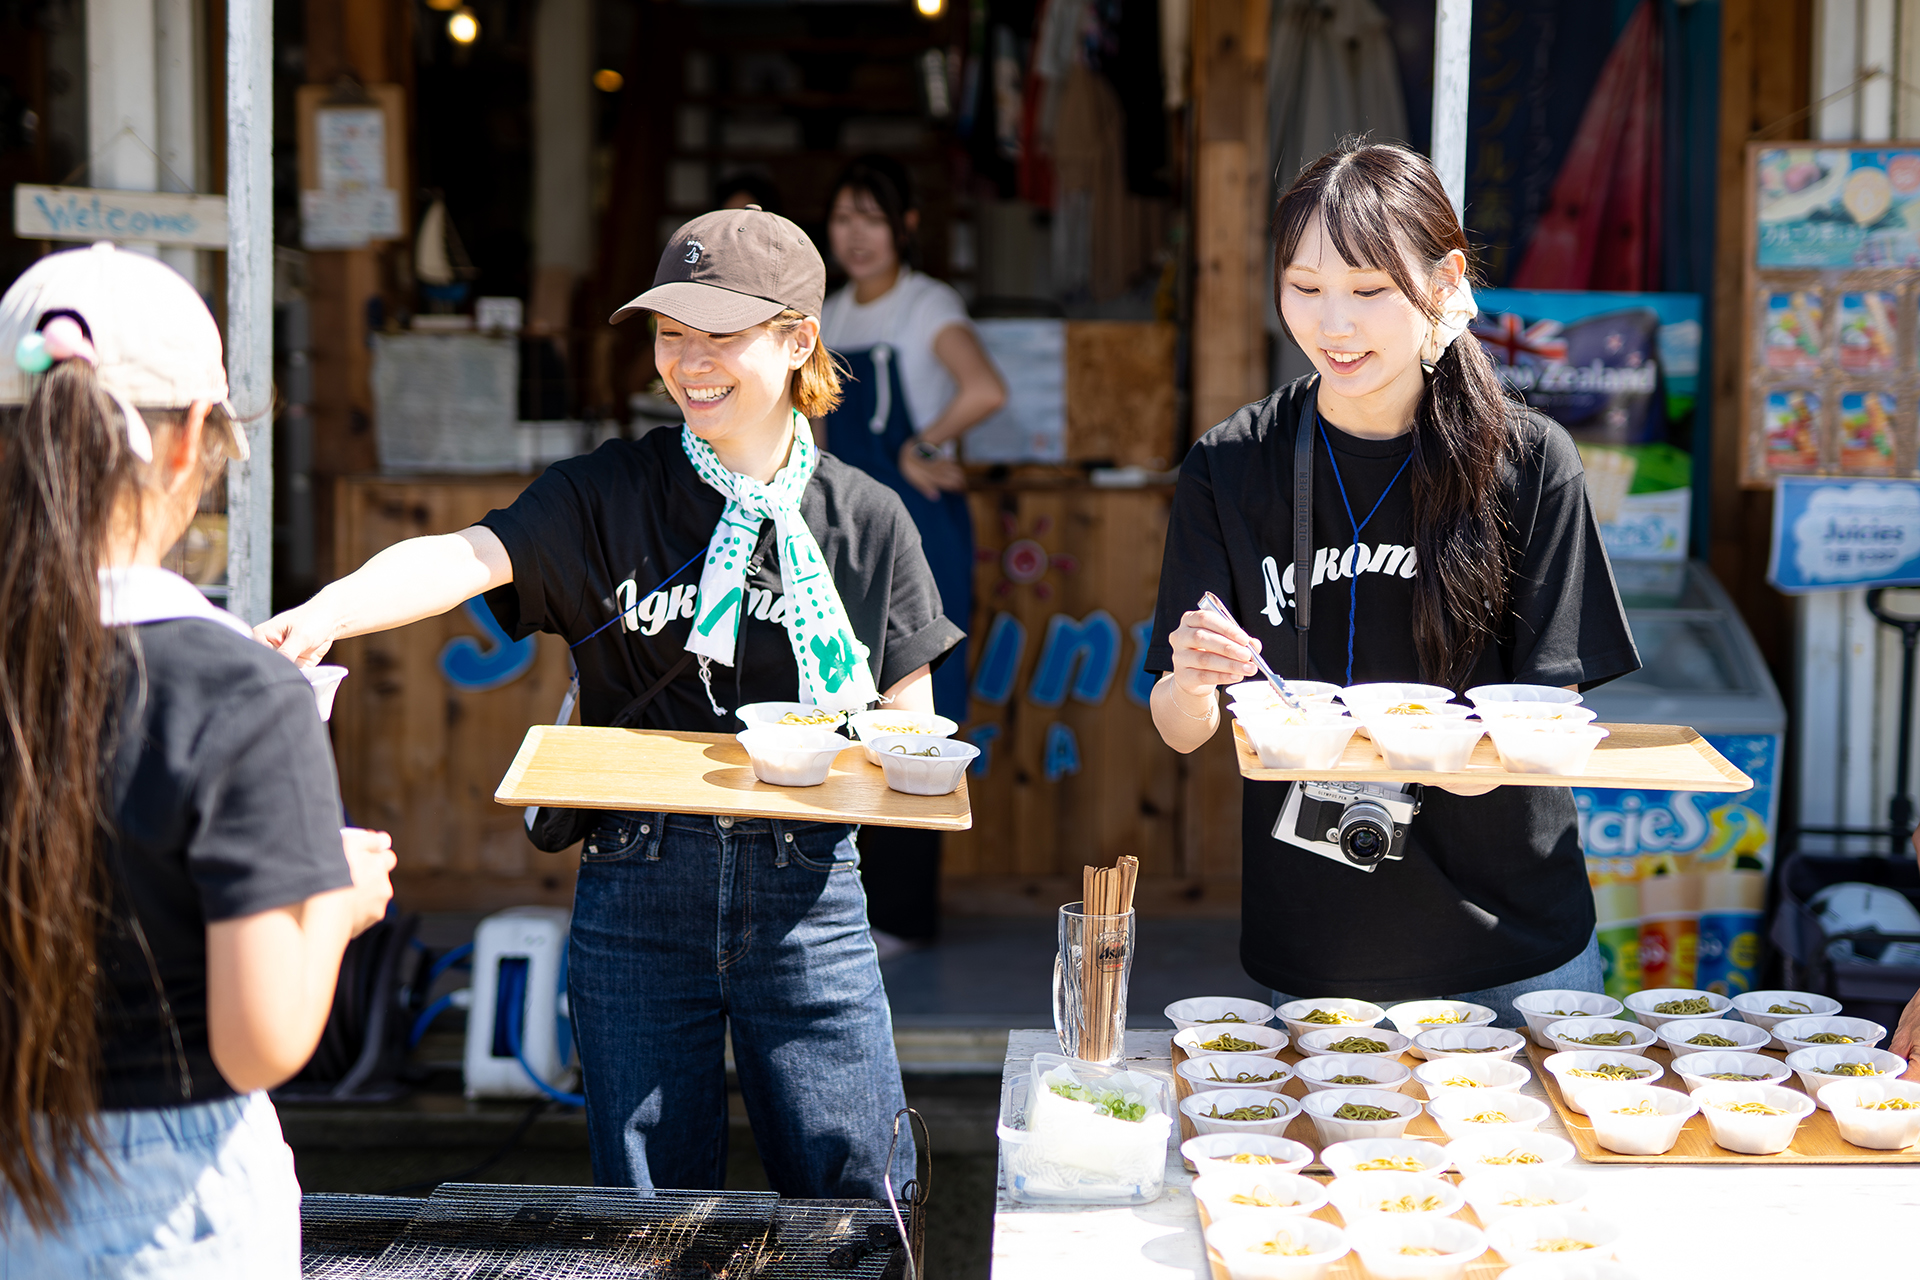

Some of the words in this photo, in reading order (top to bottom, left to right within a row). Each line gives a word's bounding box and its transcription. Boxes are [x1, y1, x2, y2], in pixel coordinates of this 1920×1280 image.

[33, 193, 200, 236] Welcome
[1540, 357, 1657, 393] Zealand
[1317, 790, 1337, 799] OLYMPUS
